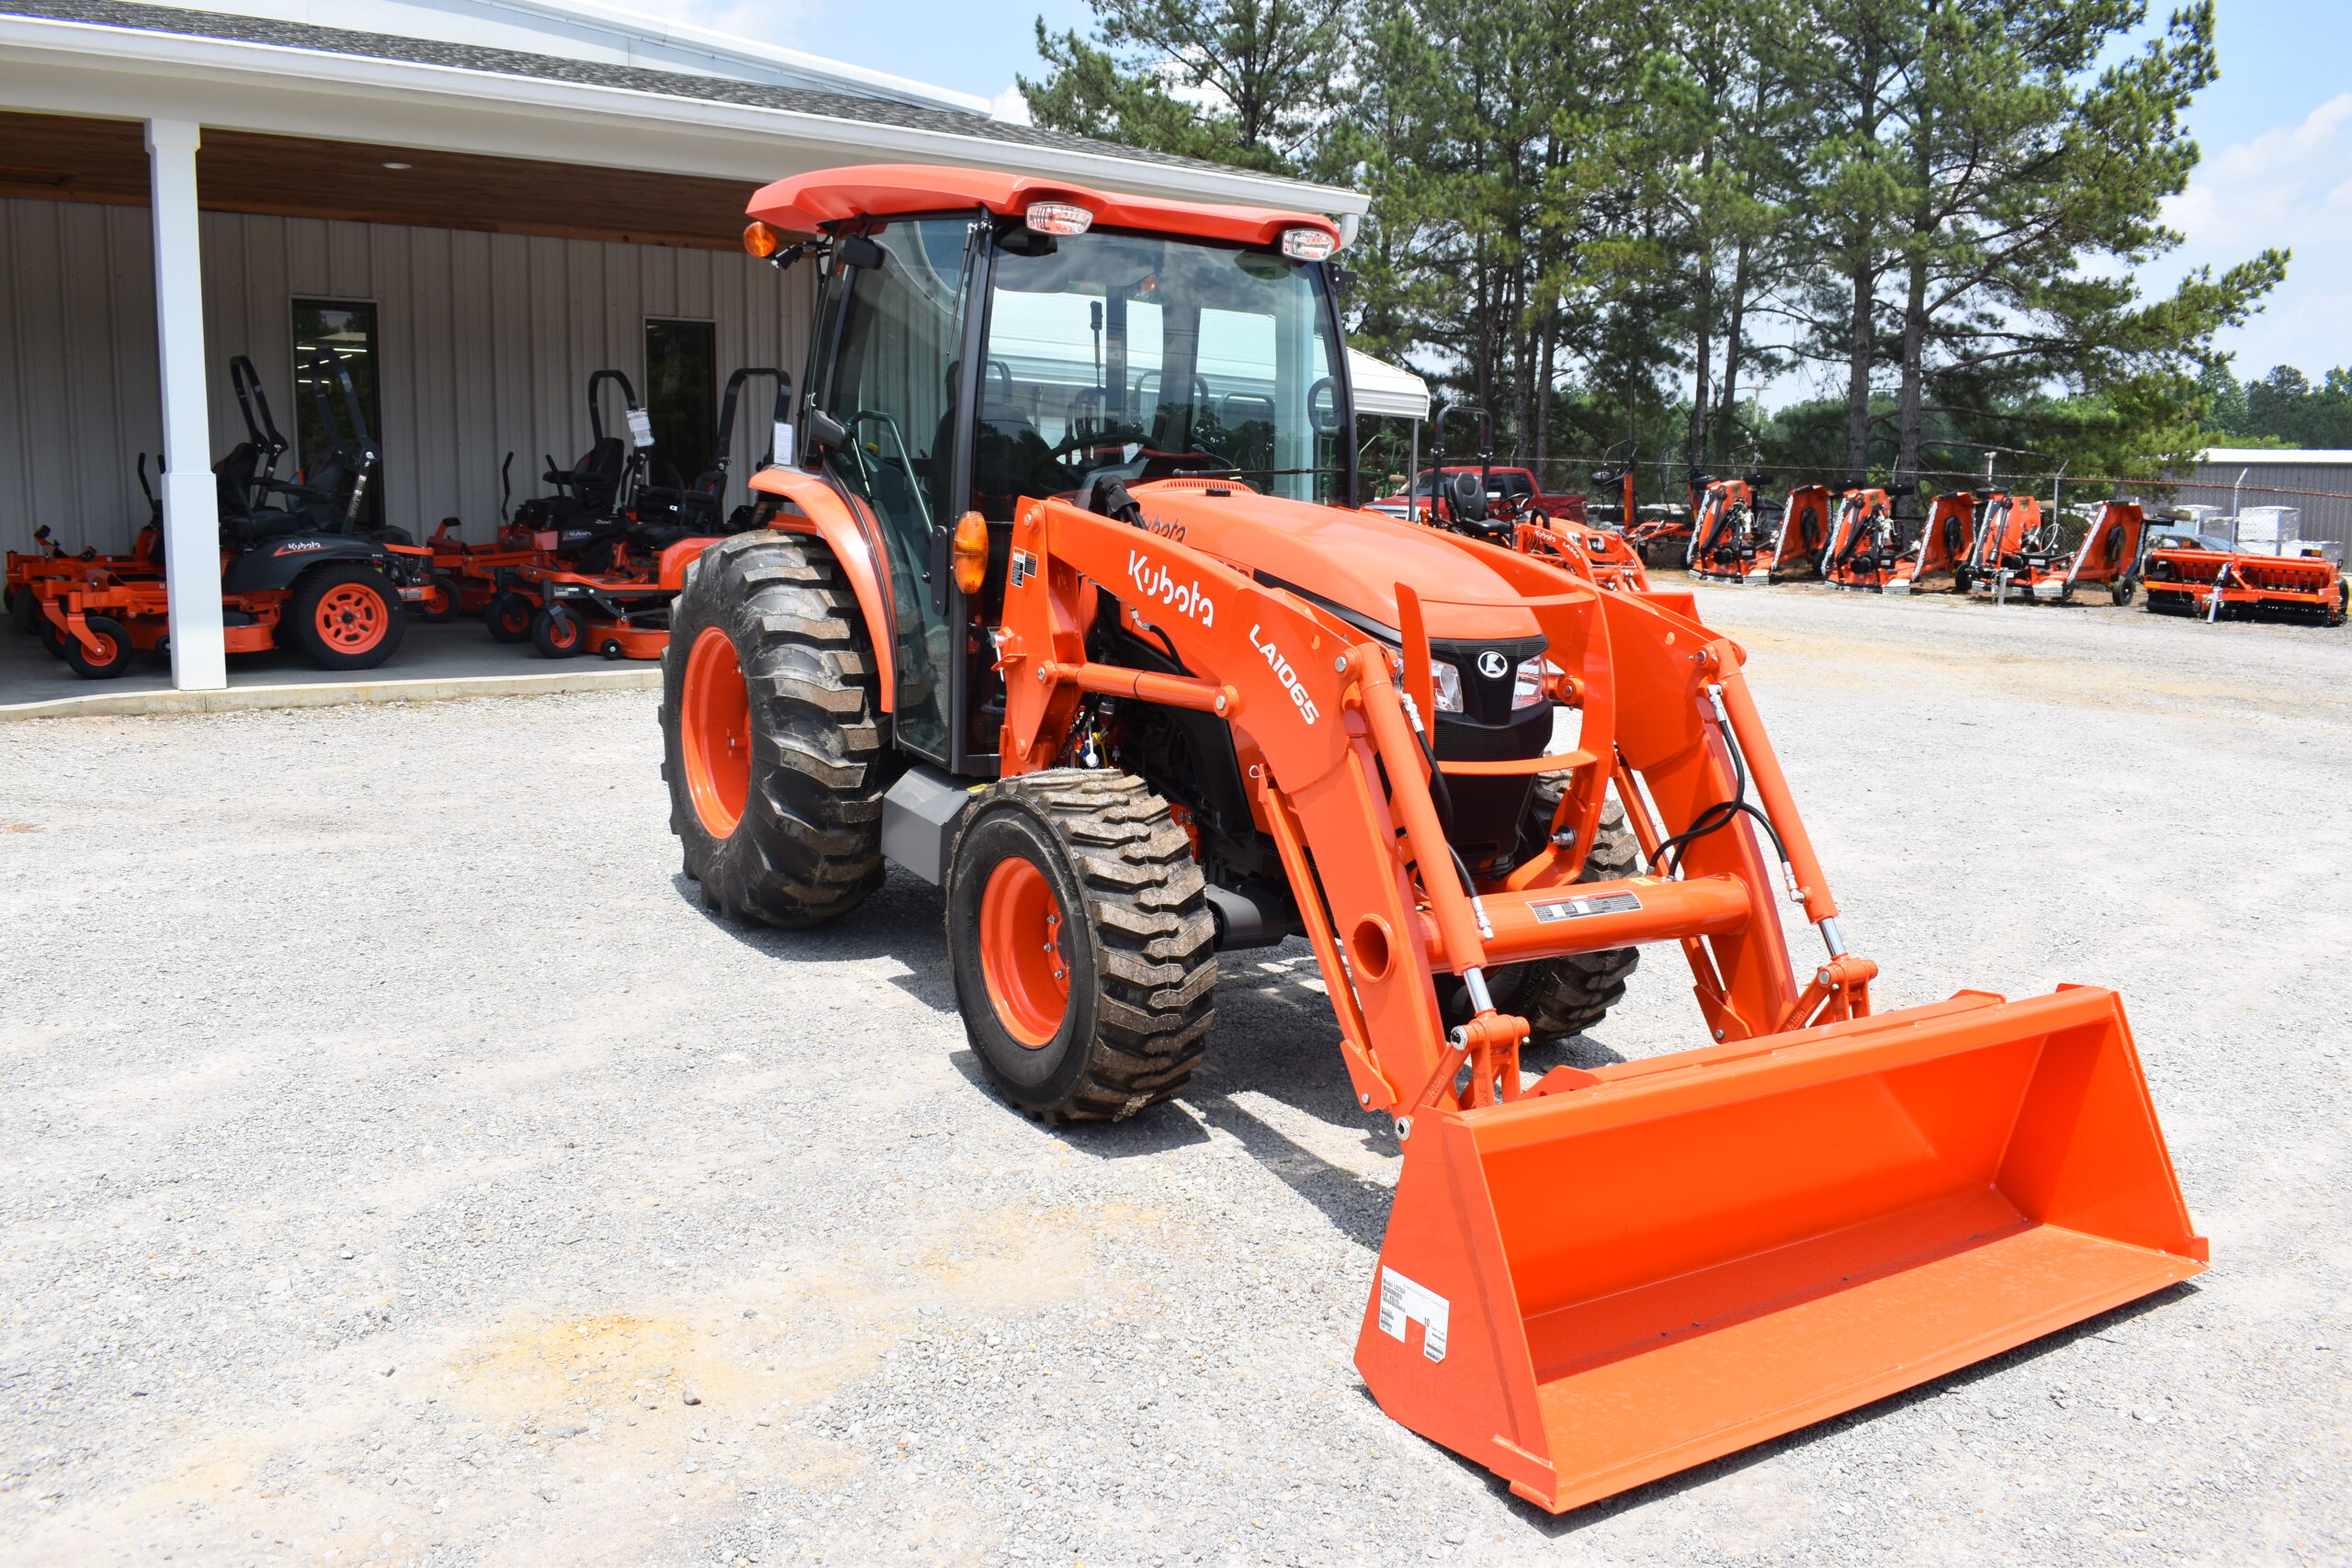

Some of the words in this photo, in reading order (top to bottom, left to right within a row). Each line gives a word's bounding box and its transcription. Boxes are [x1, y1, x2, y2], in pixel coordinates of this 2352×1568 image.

[288, 541, 322, 550] Kubota
[1534, 529, 1556, 543] Kubota
[1127, 549, 1214, 627] Kubota
[1249, 623, 1320, 725] LA1065
